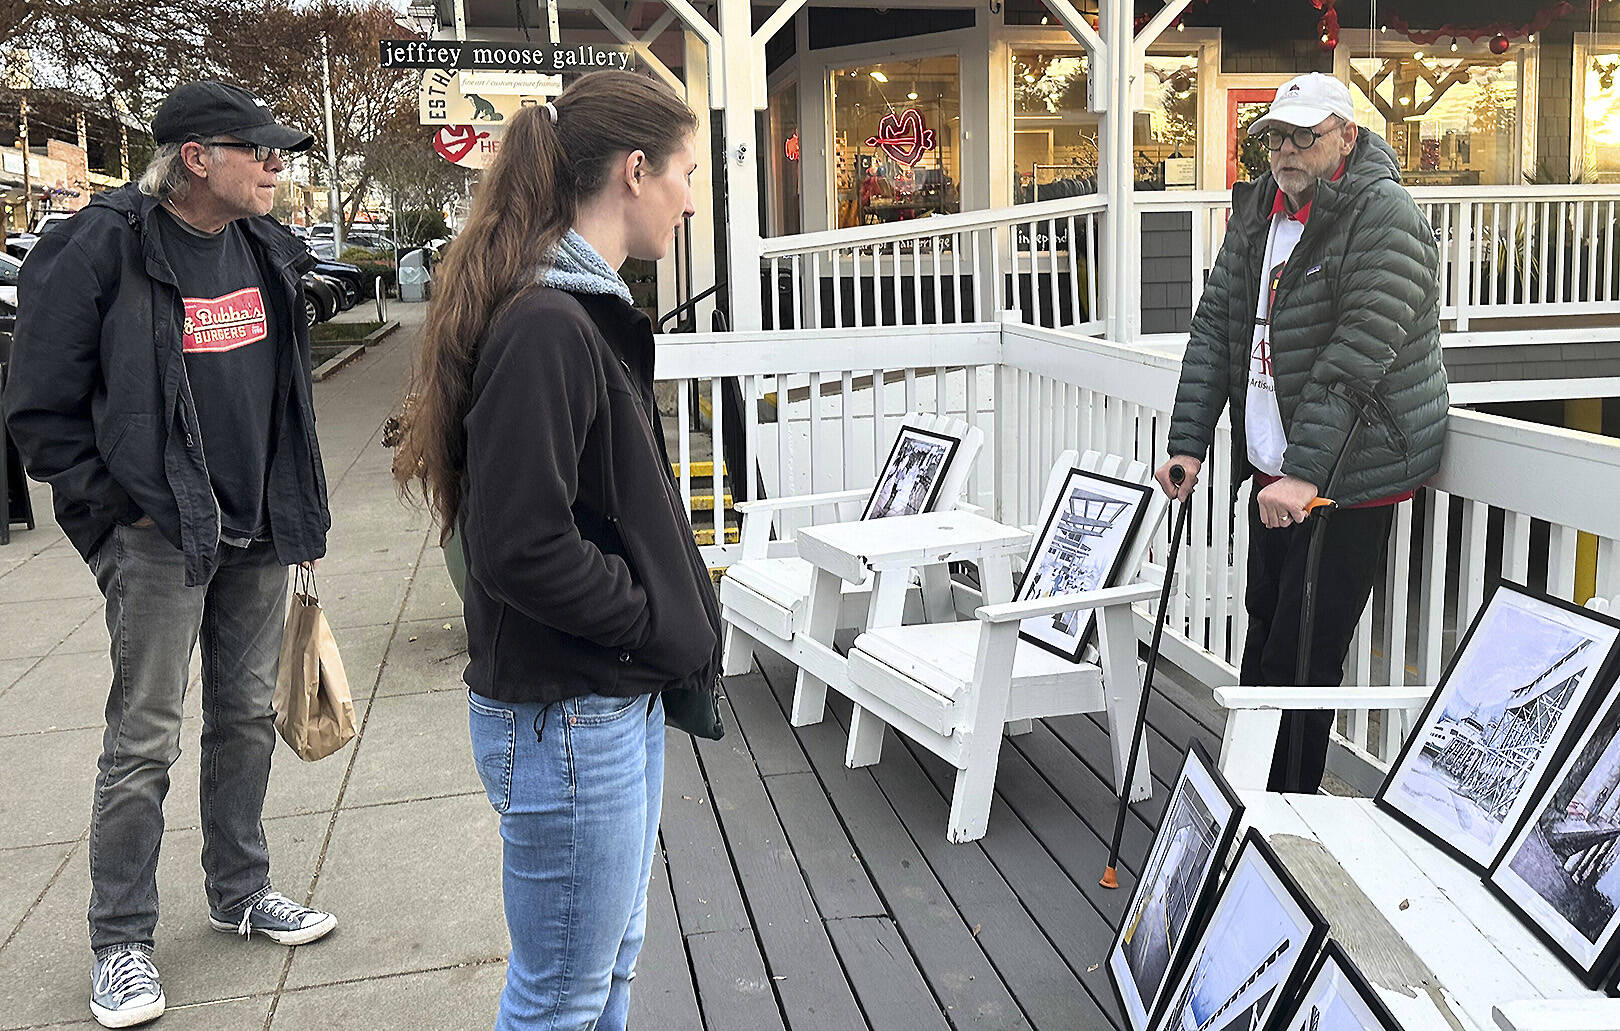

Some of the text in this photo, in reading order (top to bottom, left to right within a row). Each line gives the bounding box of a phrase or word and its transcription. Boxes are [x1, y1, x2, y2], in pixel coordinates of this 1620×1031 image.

[384, 41, 630, 70] jeffrey moose gallery
[184, 302, 265, 335] & Bubba's
[195, 327, 246, 344] BURGERS
